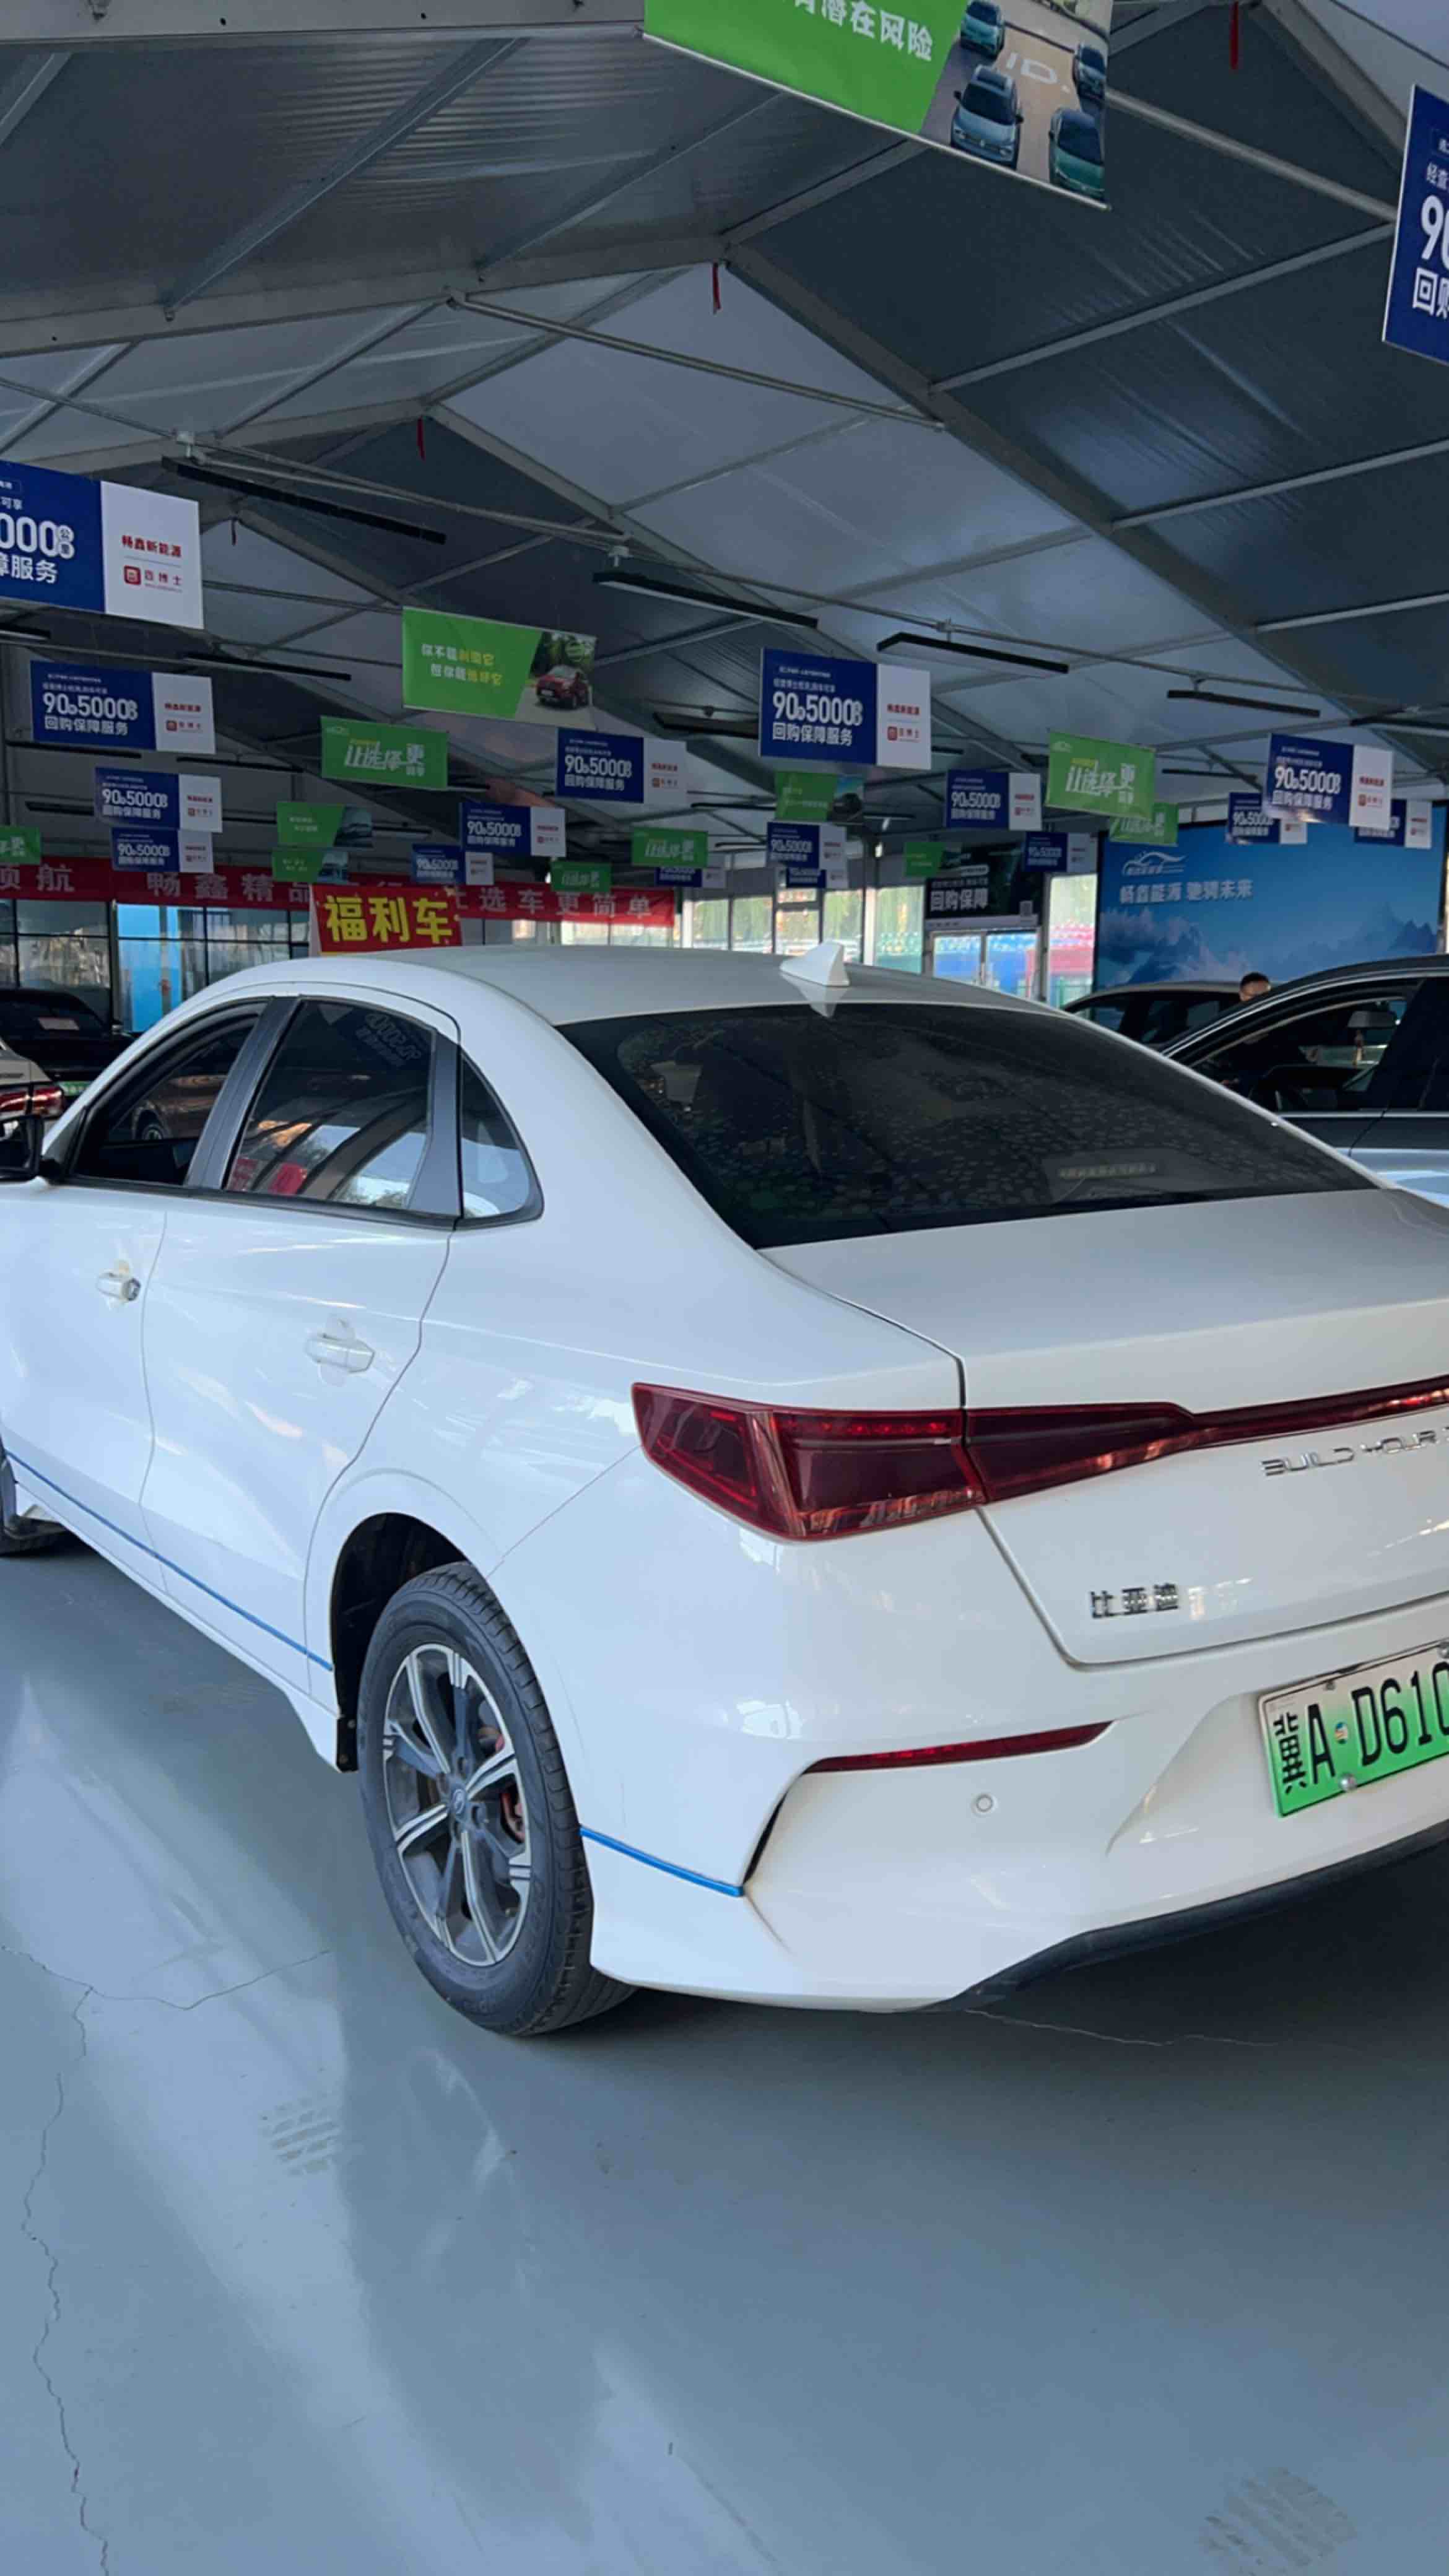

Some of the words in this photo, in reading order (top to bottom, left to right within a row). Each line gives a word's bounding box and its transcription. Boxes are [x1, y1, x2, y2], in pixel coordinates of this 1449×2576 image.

[773, 721, 853, 746] 回购保障服务
[324, 895, 453, 944] 福利车
[1260, 1446, 1355, 1477] BUILD
[1360, 1430, 1438, 1455] YOUR
[1090, 1583, 1178, 1619] 比亚迪
